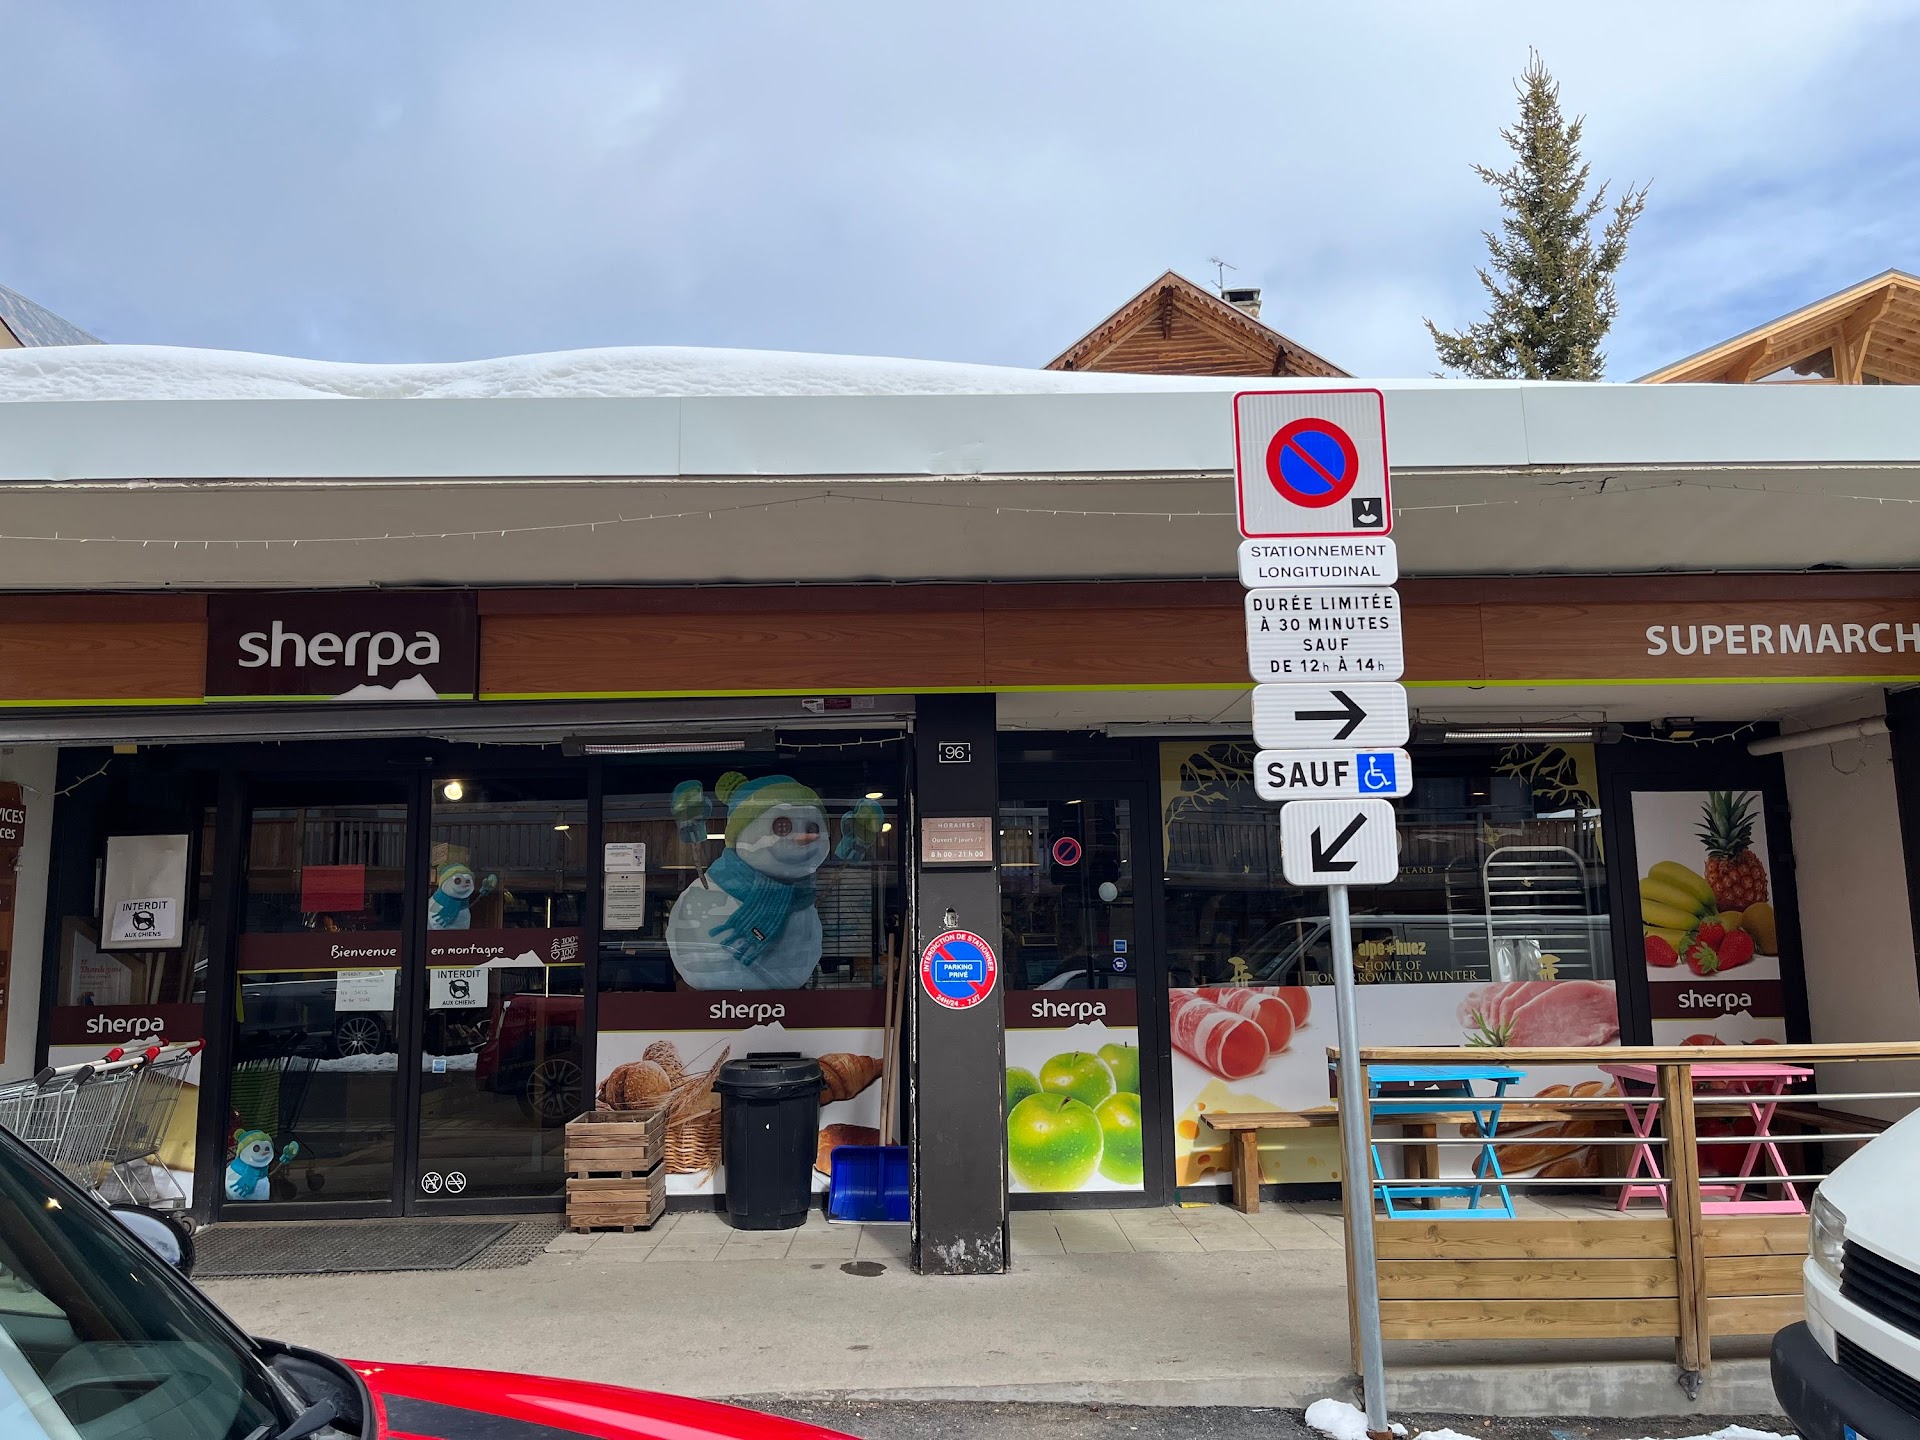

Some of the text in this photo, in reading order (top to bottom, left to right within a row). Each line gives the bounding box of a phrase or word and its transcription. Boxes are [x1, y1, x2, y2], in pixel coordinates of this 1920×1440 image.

[1251, 545, 1386, 557] STATIONNEMENT
[1259, 566, 1380, 578] LONGITUDINAL
[1253, 594, 1393, 611] DURÉE LIMITÉE
[1260, 616, 1390, 632] À 30 MINUTES
[1303, 638, 1349, 652] SAUF
[1645, 622, 1920, 656] SUPERMARCH
[238, 620, 440, 676] sherpa
[1270, 660, 1292, 673] DE
[1338, 656, 1348, 672] À
[945, 746, 965, 759] 96
[1267, 760, 1350, 788] SAUF
[122, 901, 168, 912] INTERDIT
[331, 944, 397, 958] Bienvenue
[431, 944, 504, 958] en montagne
[924, 934, 954, 972] INTERDICTION
[967, 935, 994, 972] STATIONNER
[1364, 960, 1422, 971] HOME OF
[438, 970, 480, 978] INTERDIT
[1310, 970, 1477, 984] TOROWLAND WINTER
[936, 994, 958, 1006] 24H/24
[1678, 990, 1752, 1010] sherpa
[710, 1000, 786, 1022] sherpa
[1031, 998, 1106, 1020] sherpa
[86, 1014, 164, 1036] sherpa
